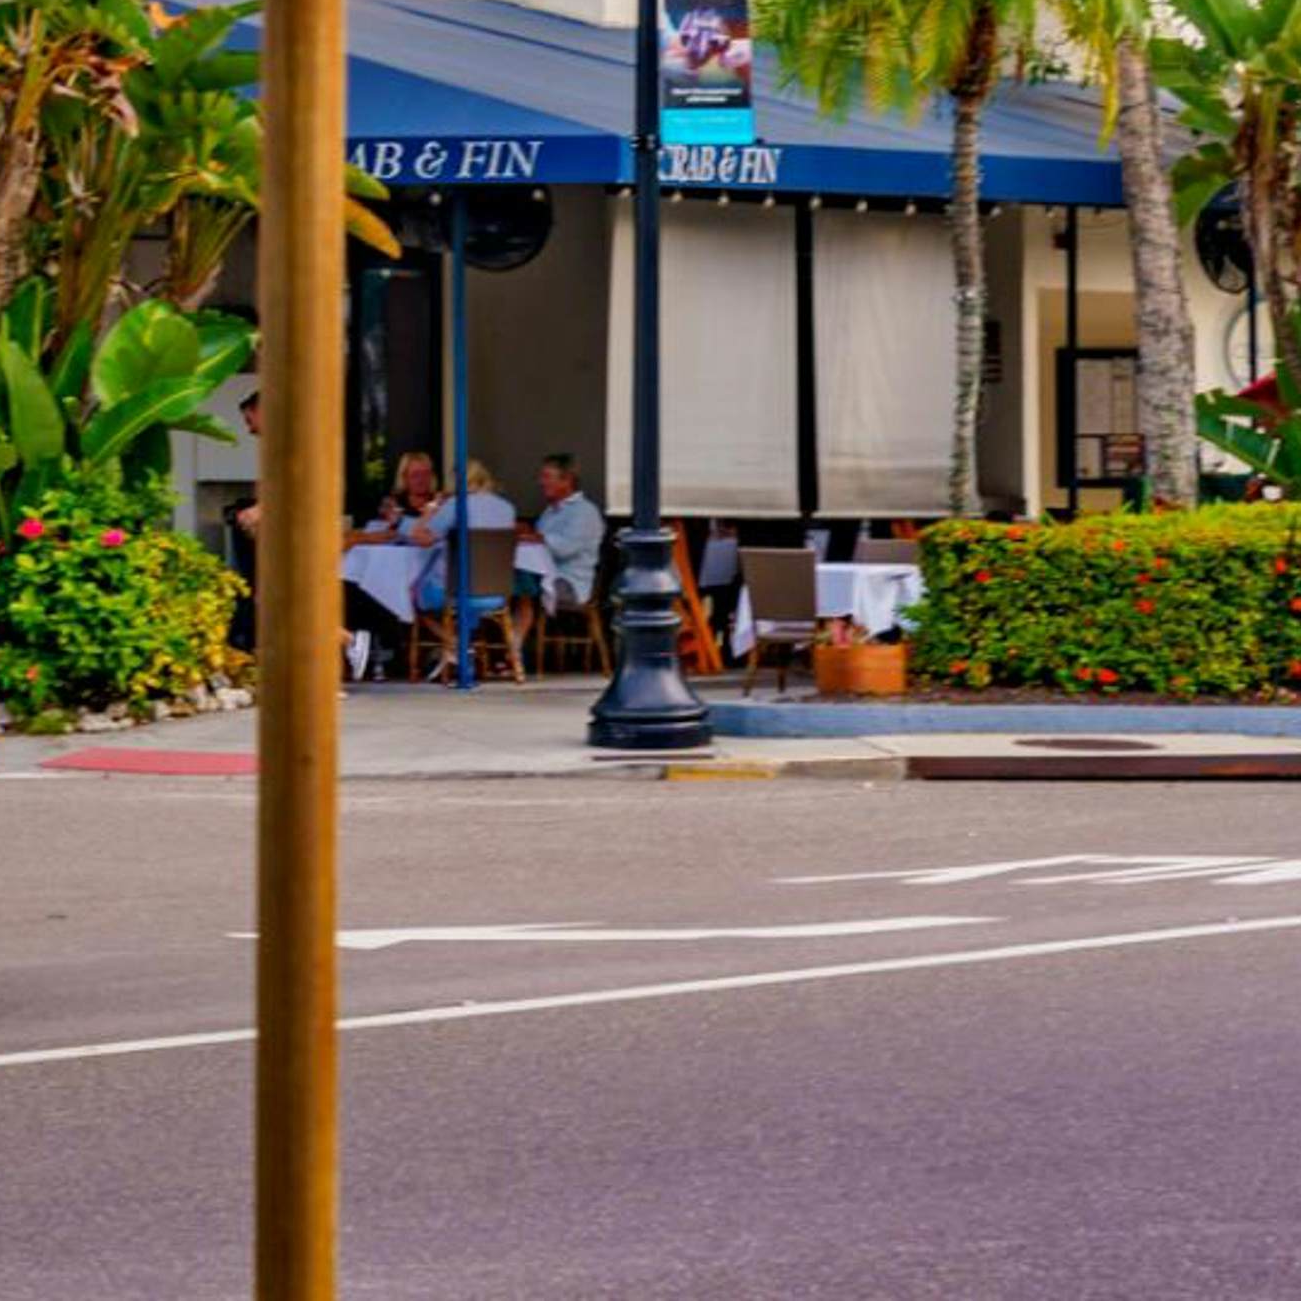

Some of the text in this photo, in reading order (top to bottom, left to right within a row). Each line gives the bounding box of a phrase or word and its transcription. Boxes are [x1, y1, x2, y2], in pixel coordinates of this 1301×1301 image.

[350, 140, 546, 180] AB & FIN
[717, 145, 738, 183] &
